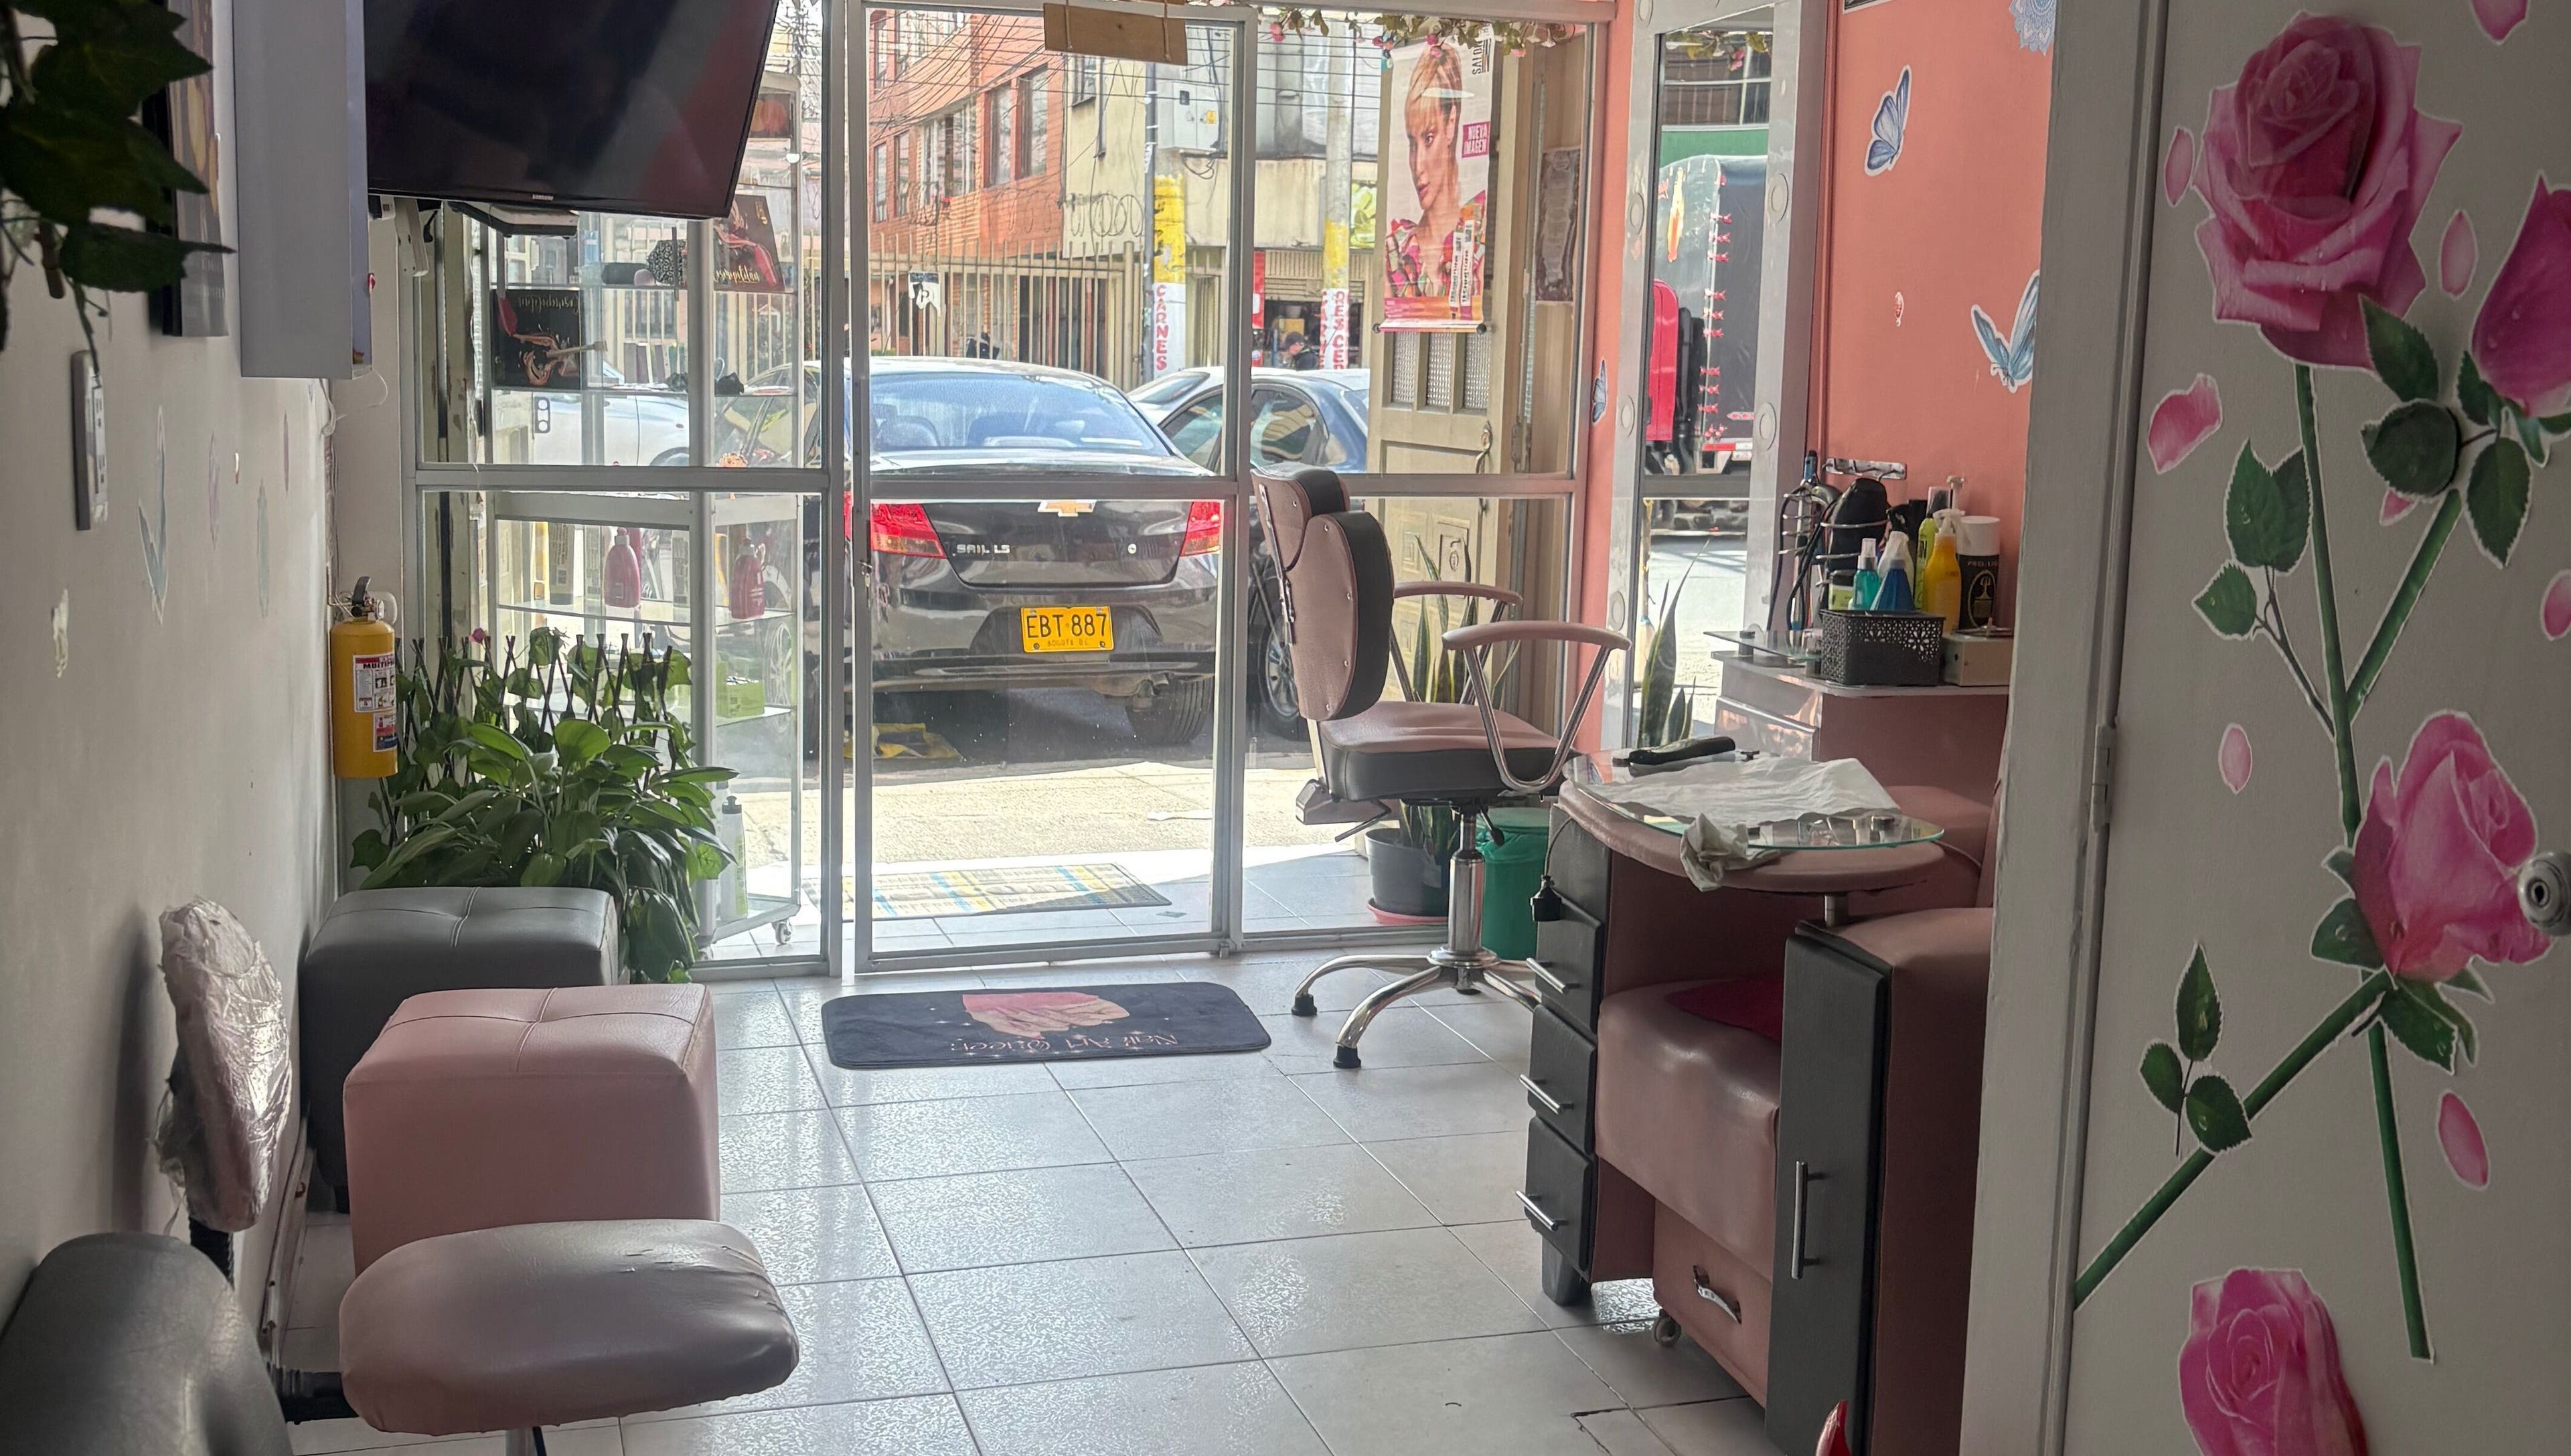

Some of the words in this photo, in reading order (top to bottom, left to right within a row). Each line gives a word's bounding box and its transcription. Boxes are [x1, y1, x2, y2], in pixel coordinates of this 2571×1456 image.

[1468, 124, 1487, 140] NUEVA
[1464, 139, 1487, 154] IMAGEN
[1156, 284, 1170, 371] CARNES
[957, 544, 990, 555] SAIL
[994, 544, 1010, 554] LS
[1026, 614, 1064, 638] EBT
[1071, 613, 1107, 637] 887
